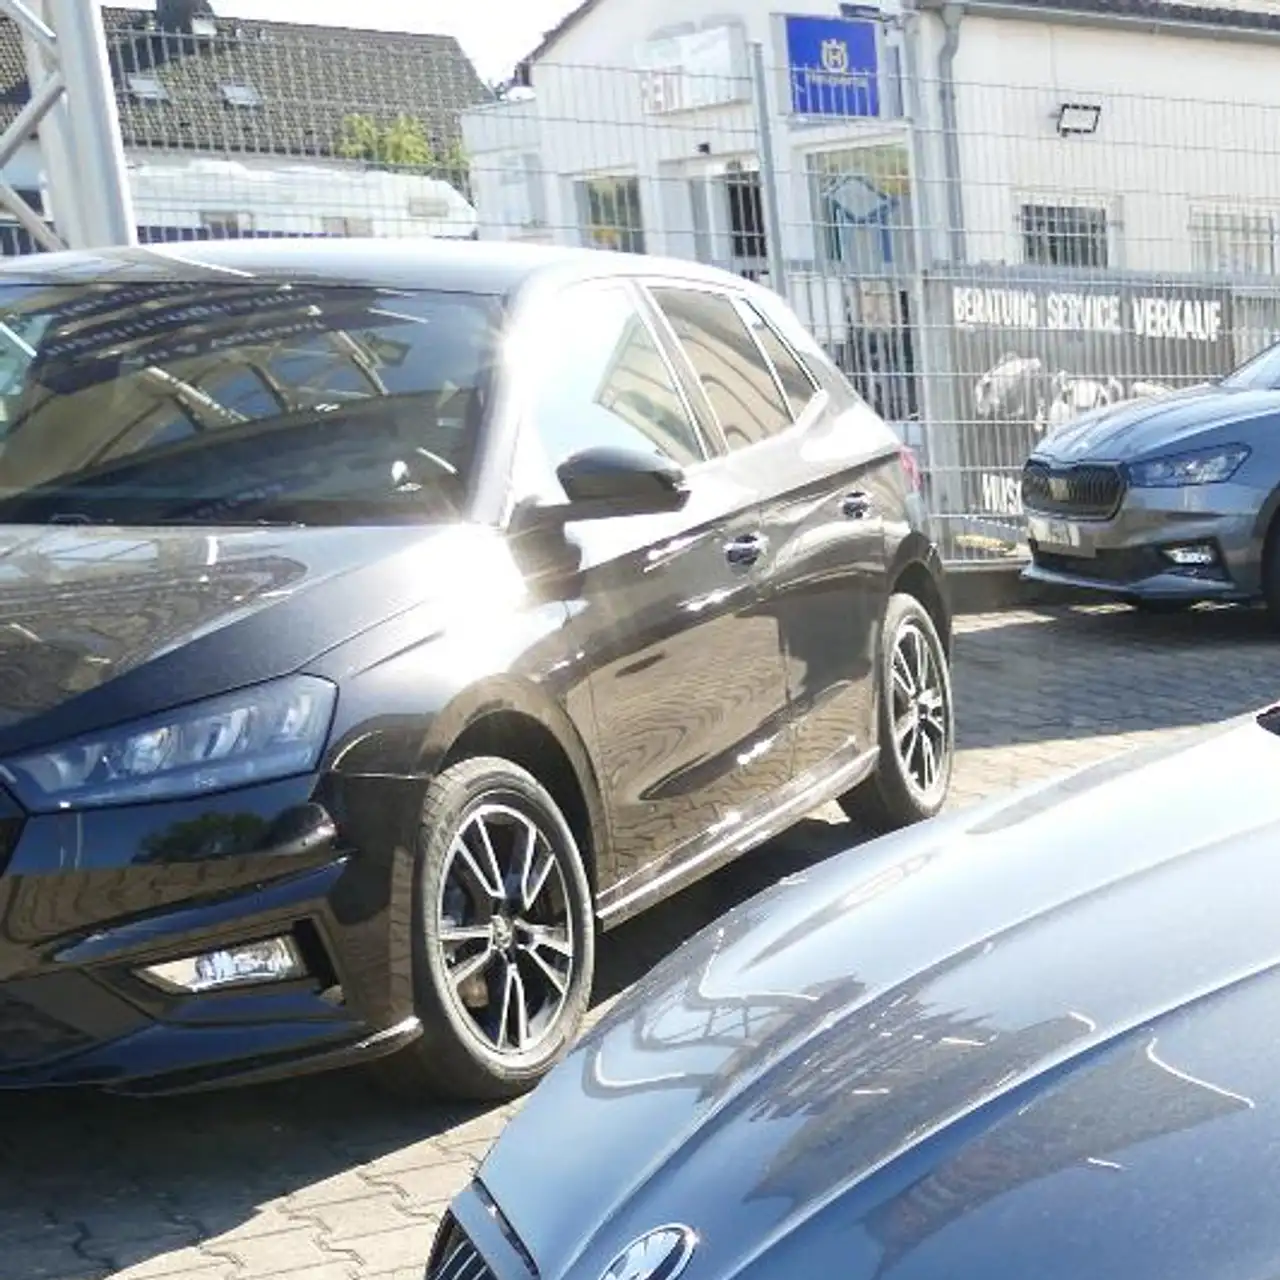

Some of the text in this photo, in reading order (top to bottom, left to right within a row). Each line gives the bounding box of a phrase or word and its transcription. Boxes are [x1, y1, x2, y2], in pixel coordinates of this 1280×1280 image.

[953, 286, 1222, 341] BERATUNG SERVICE VERKAUF
